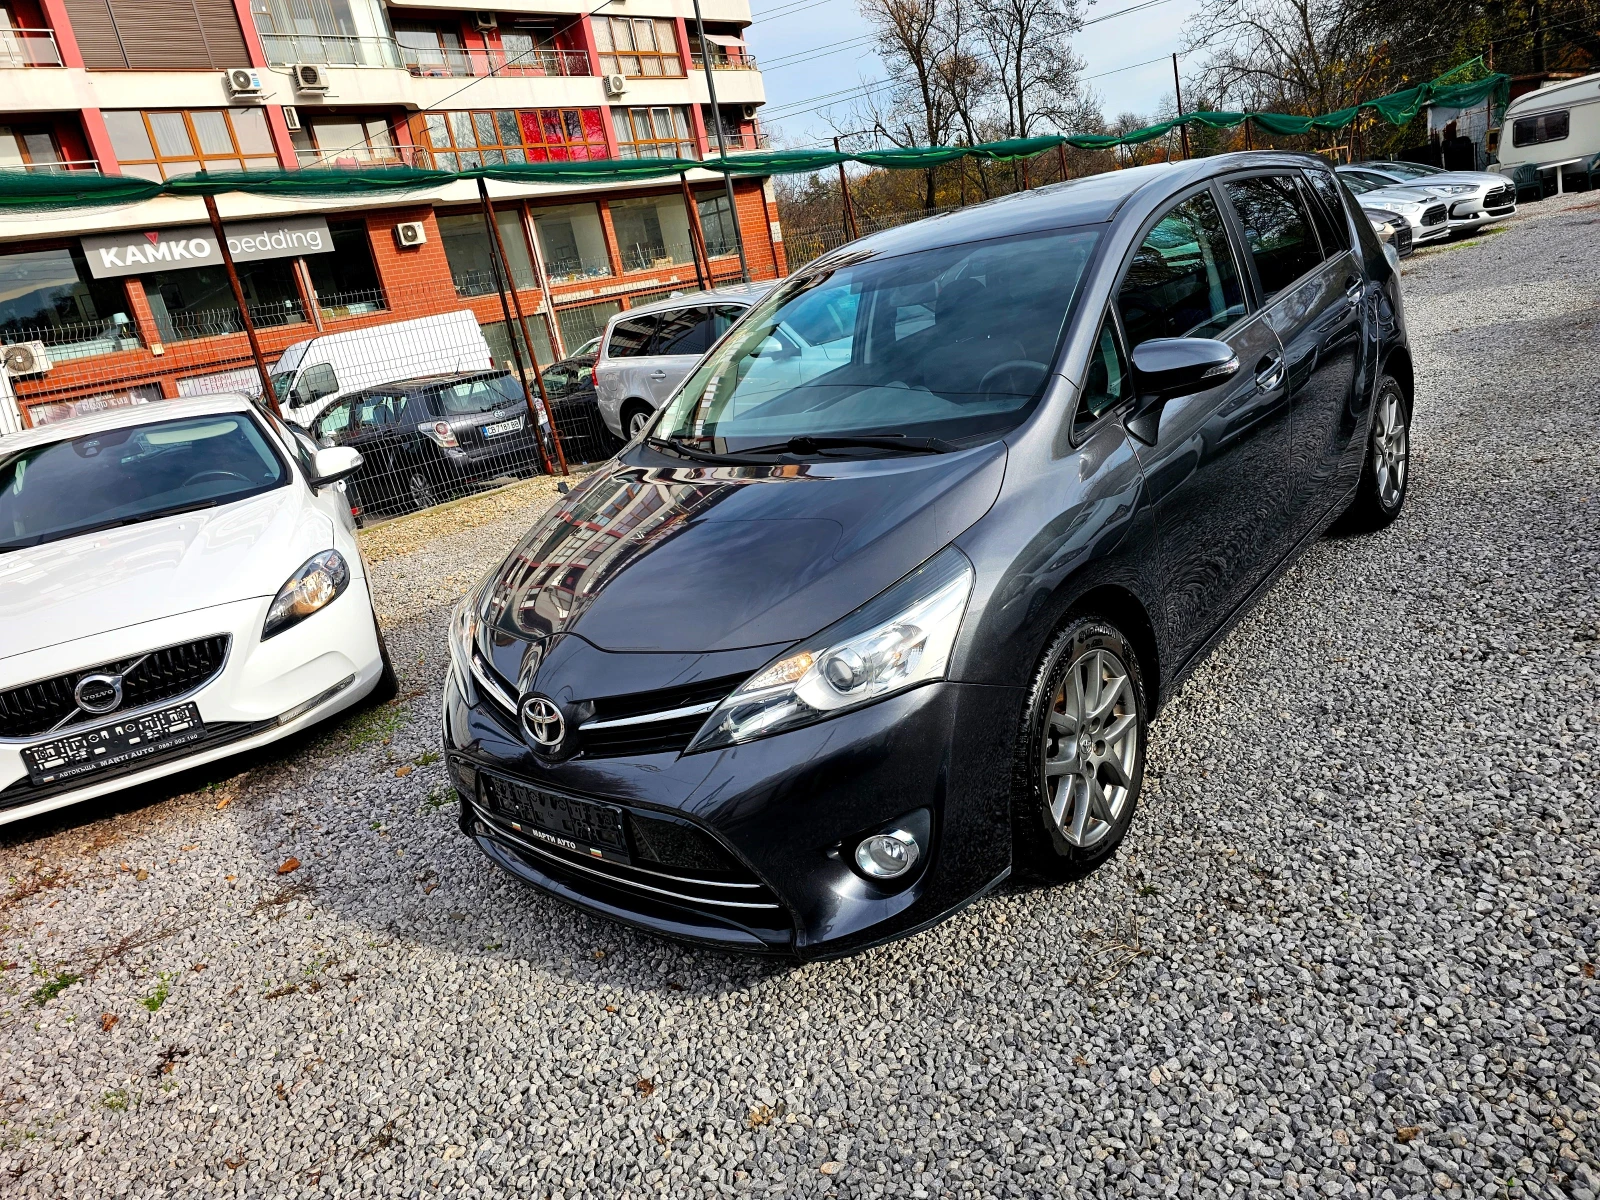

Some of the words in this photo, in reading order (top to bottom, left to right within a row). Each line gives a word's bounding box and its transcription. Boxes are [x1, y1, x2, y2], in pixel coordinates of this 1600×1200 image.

[100, 238, 211, 268] KAMKO
[82, 689, 114, 701] VOLVO
[100, 753, 129, 767] MARTI
[130, 747, 155, 760] AUTO
[532, 829, 556, 843] МАРТИ
[557, 838, 577, 850] АУТО
